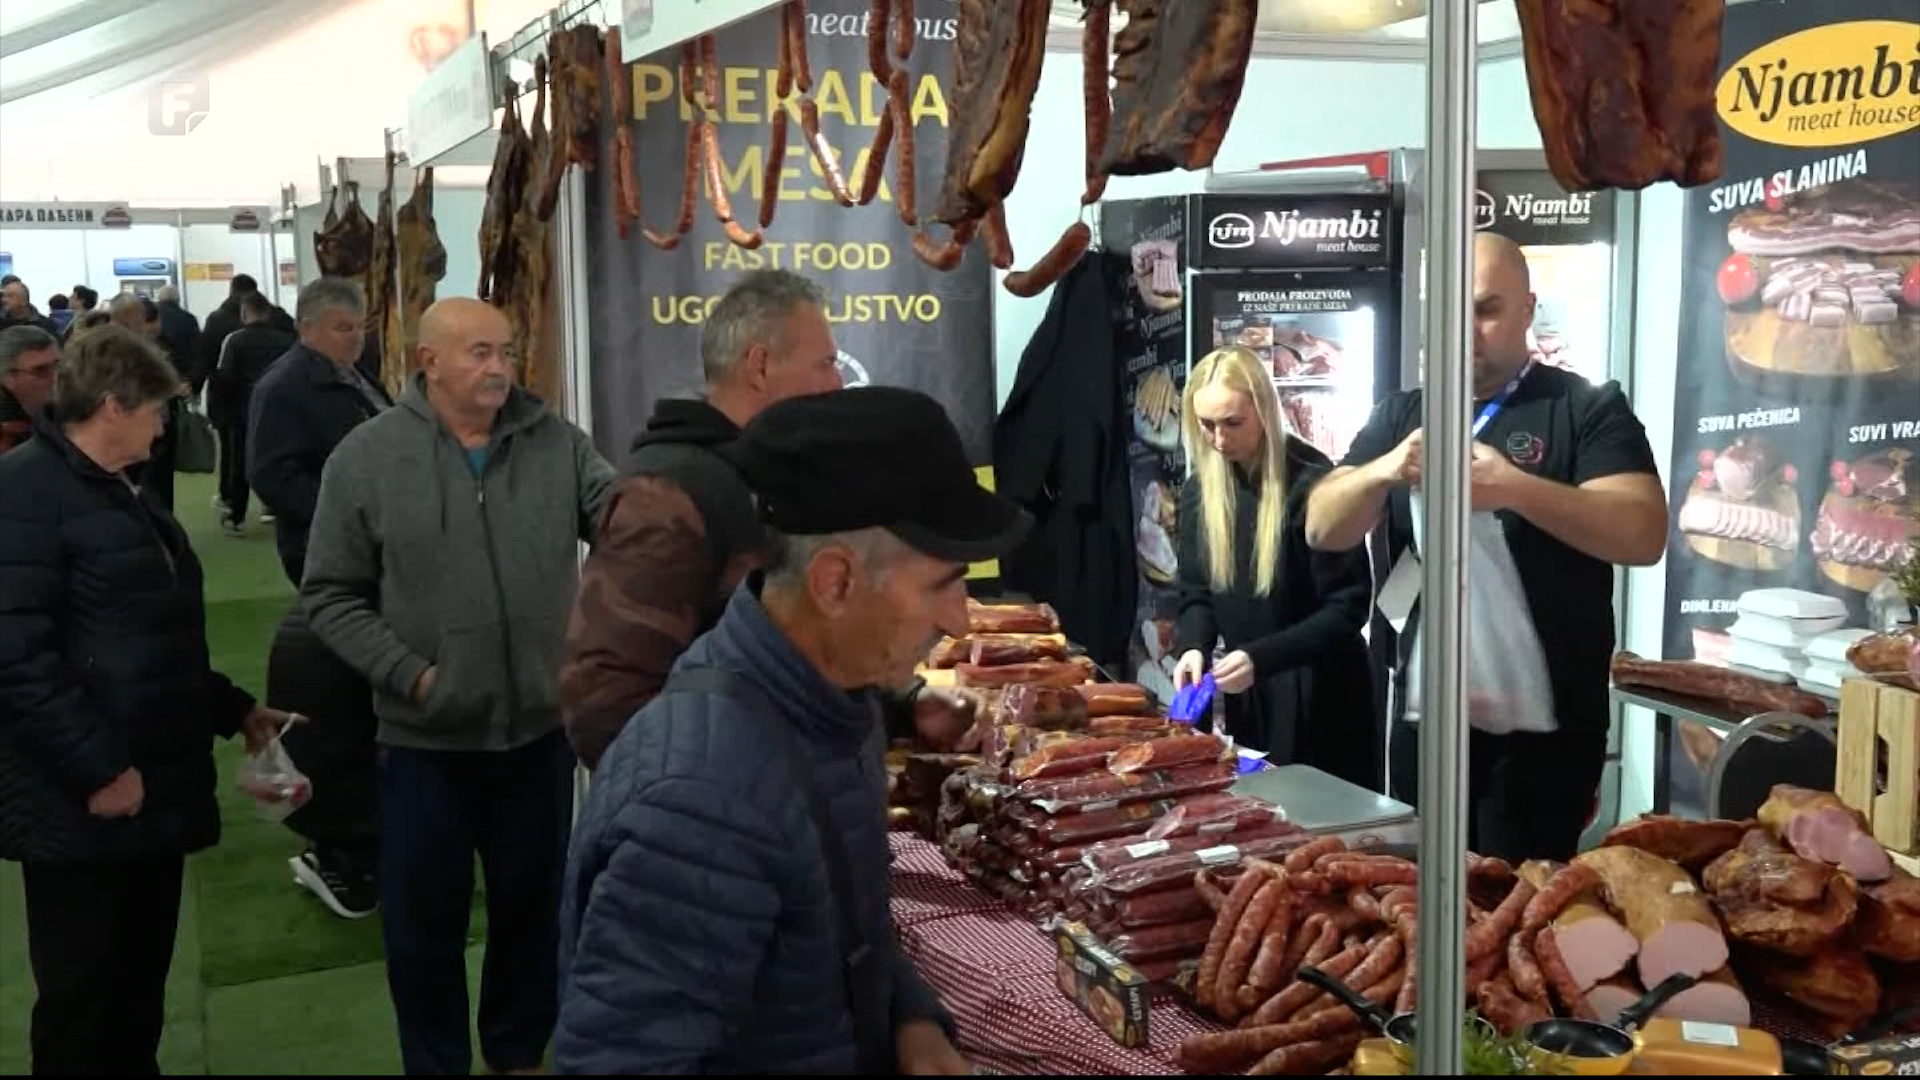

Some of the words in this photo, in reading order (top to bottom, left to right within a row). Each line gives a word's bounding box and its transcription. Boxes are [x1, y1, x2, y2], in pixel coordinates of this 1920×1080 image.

[1729, 41, 1920, 122] Njambi
[1787, 109, 1842, 132] meat
[1848, 101, 1920, 126] house
[1708, 177, 1766, 212] SUVA
[1769, 149, 1868, 198] SLANINA
[1503, 192, 1591, 221] Njambi
[1259, 209, 1382, 246] Njambi
[704, 242, 789, 271] FAST
[793, 242, 892, 271] FOOD
[1316, 242, 1345, 252] meat
[1347, 240, 1381, 252] house
[1237, 290, 1287, 301] PRODAJA
[1697, 414, 1734, 433] SUVA
[1849, 423, 1887, 443] SUVI
